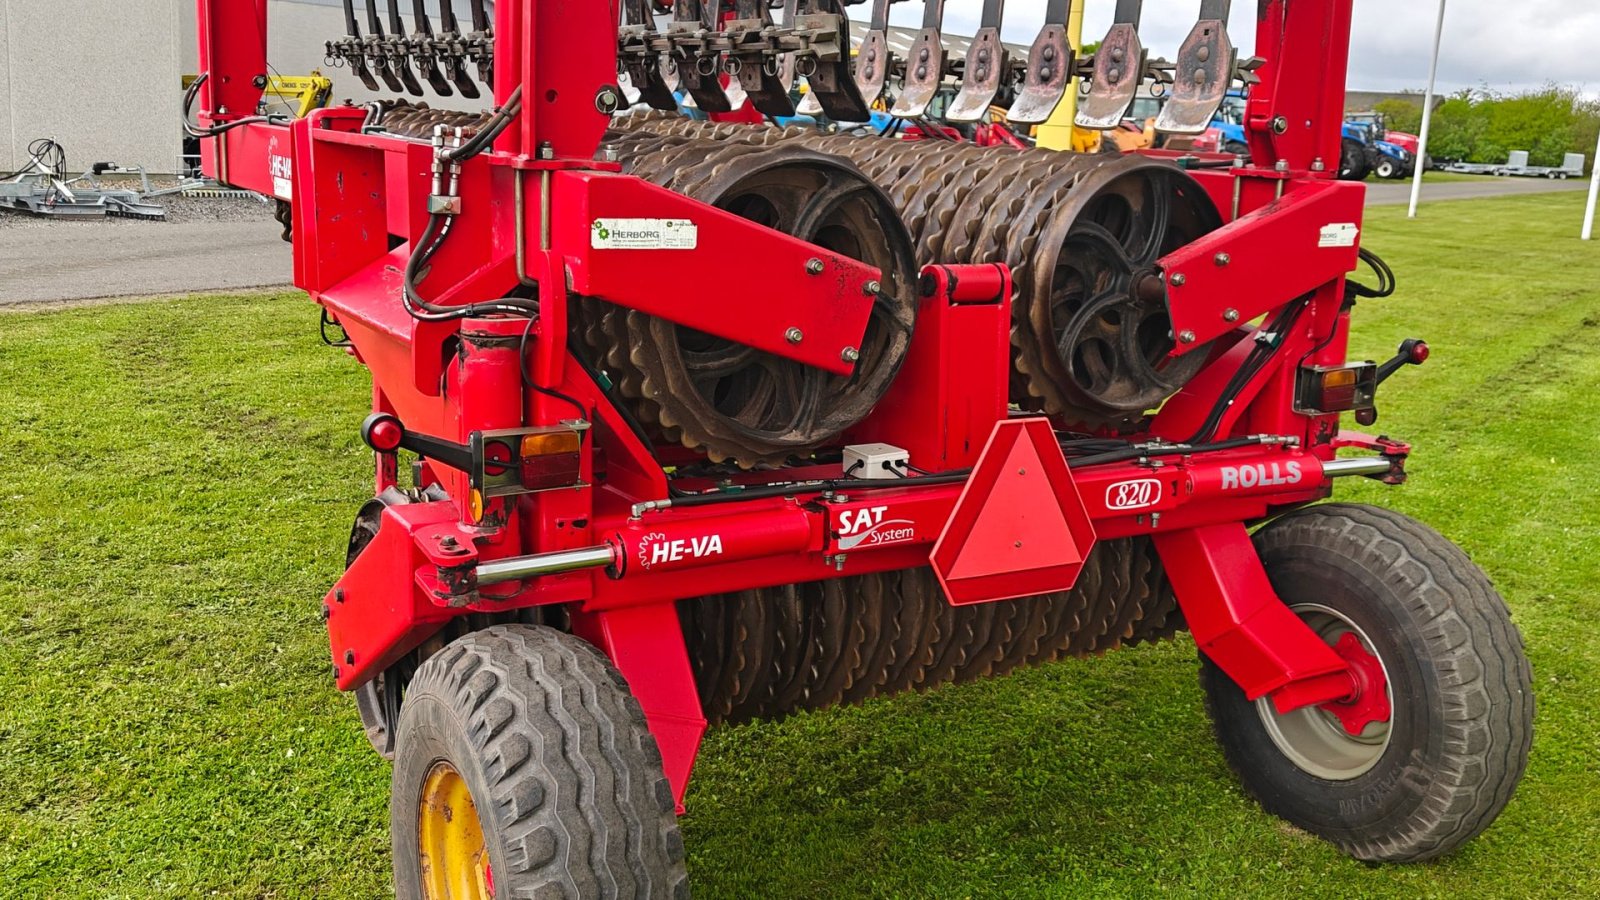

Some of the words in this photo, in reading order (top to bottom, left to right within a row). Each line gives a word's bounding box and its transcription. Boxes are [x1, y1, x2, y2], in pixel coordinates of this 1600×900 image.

[612, 230, 659, 239] HERBORG
[1221, 461, 1301, 490] ROLLS
[1115, 482, 1151, 506] 820
[838, 506, 887, 534] SAT
[870, 528, 914, 543] System
[651, 535, 723, 564] HE-VA
